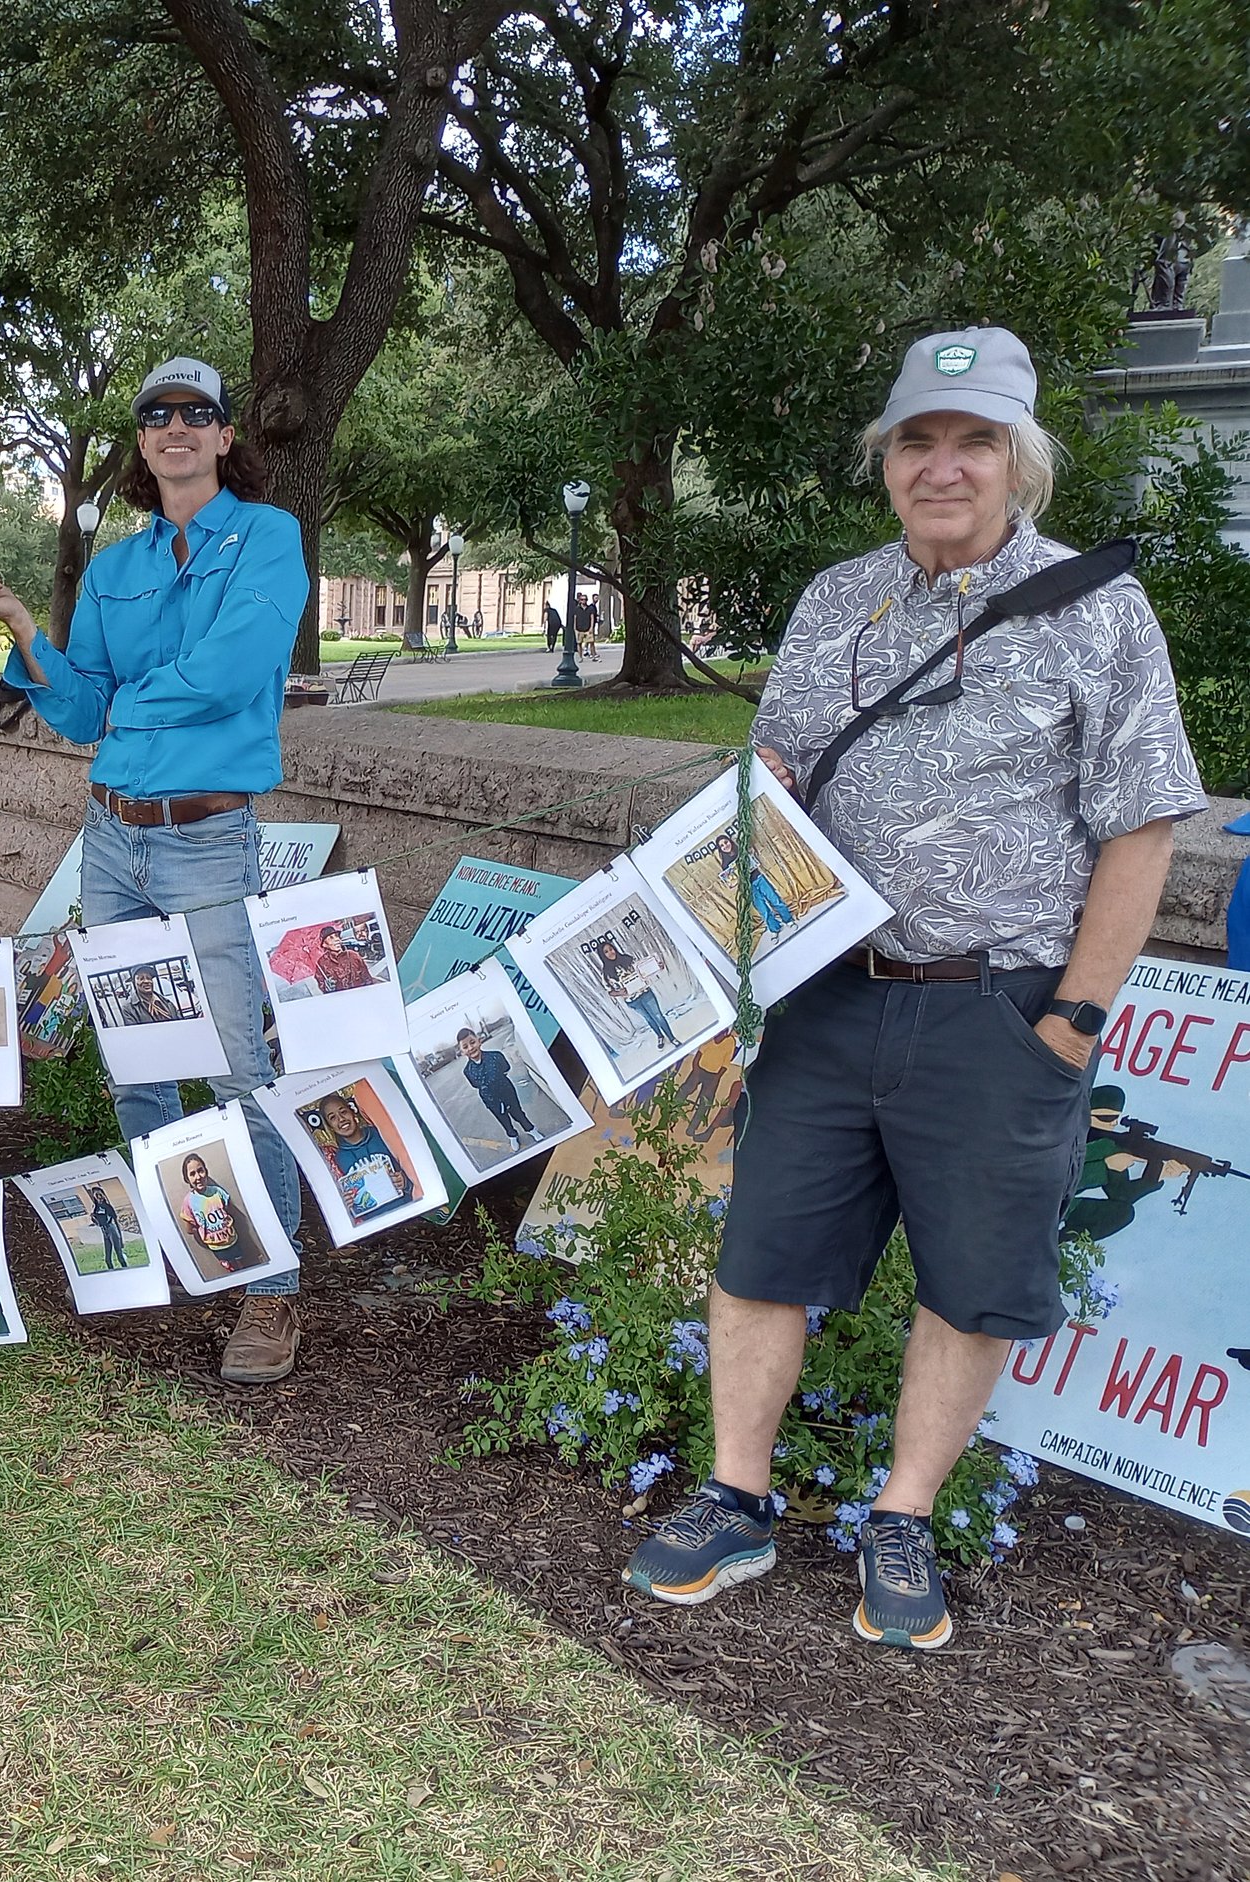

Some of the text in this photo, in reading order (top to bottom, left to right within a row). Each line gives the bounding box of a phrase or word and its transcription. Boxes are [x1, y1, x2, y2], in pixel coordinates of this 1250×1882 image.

[259, 841, 314, 869] EALING
[455, 865, 514, 892] NONVIOLENCE
[429, 898, 479, 931] BUILD
[1211, 977, 1250, 1006] MEA
[1102, 1003, 1216, 1086] AGE
[1000, 1320, 1229, 1448] OT WAR
[1040, 1429, 1222, 1512] CAMPAIGN NONVIOLENCE
